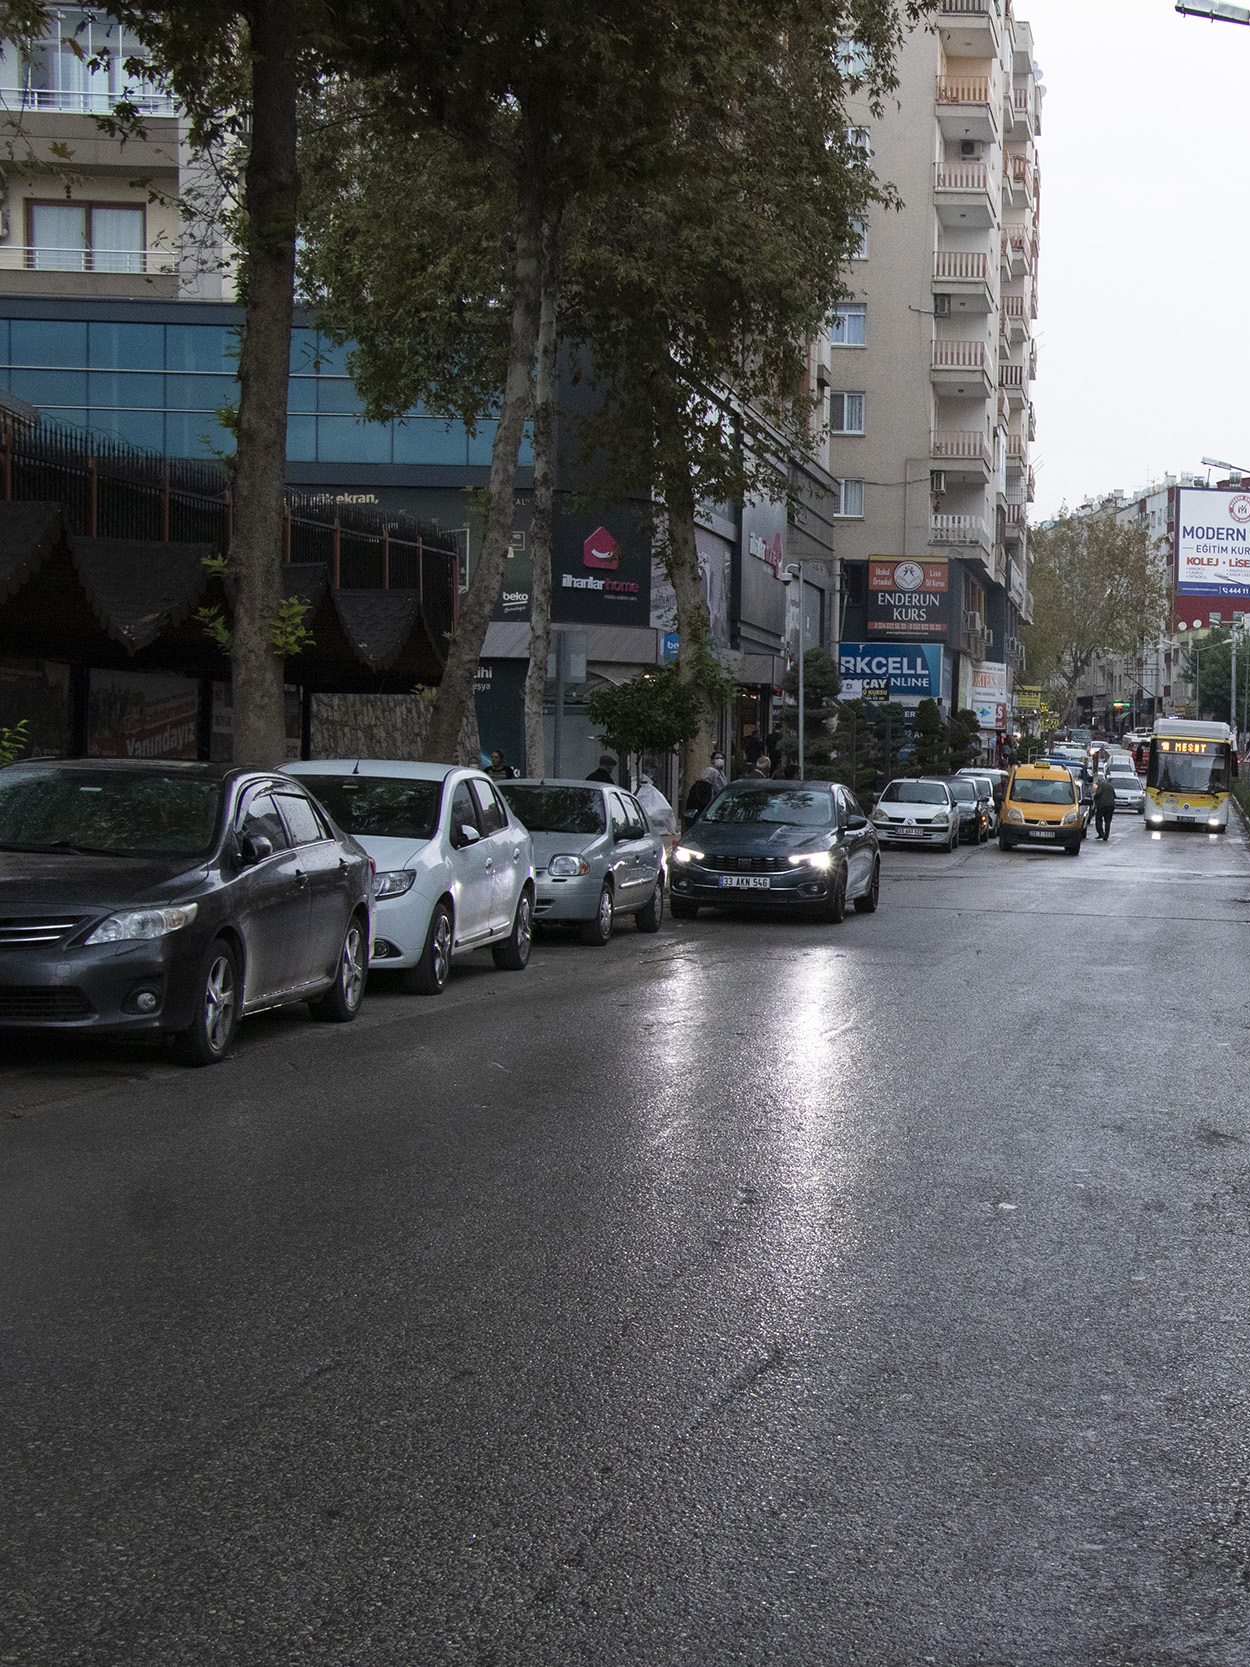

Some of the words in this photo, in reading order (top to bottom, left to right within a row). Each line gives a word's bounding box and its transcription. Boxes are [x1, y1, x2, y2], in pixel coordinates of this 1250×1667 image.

[336, 492, 380, 505] ekran,
[1182, 525, 1246, 542] MODERN
[1196, 543, 1228, 554] EĞİTİM
[1186, 557, 1219, 567] KOLEJ
[502, 591, 529, 601] beko
[878, 592, 940, 607] ENDERUN
[893, 608, 927, 621] KURS
[723, 878, 734, 886] 33
[735, 878, 751, 887] AKN
